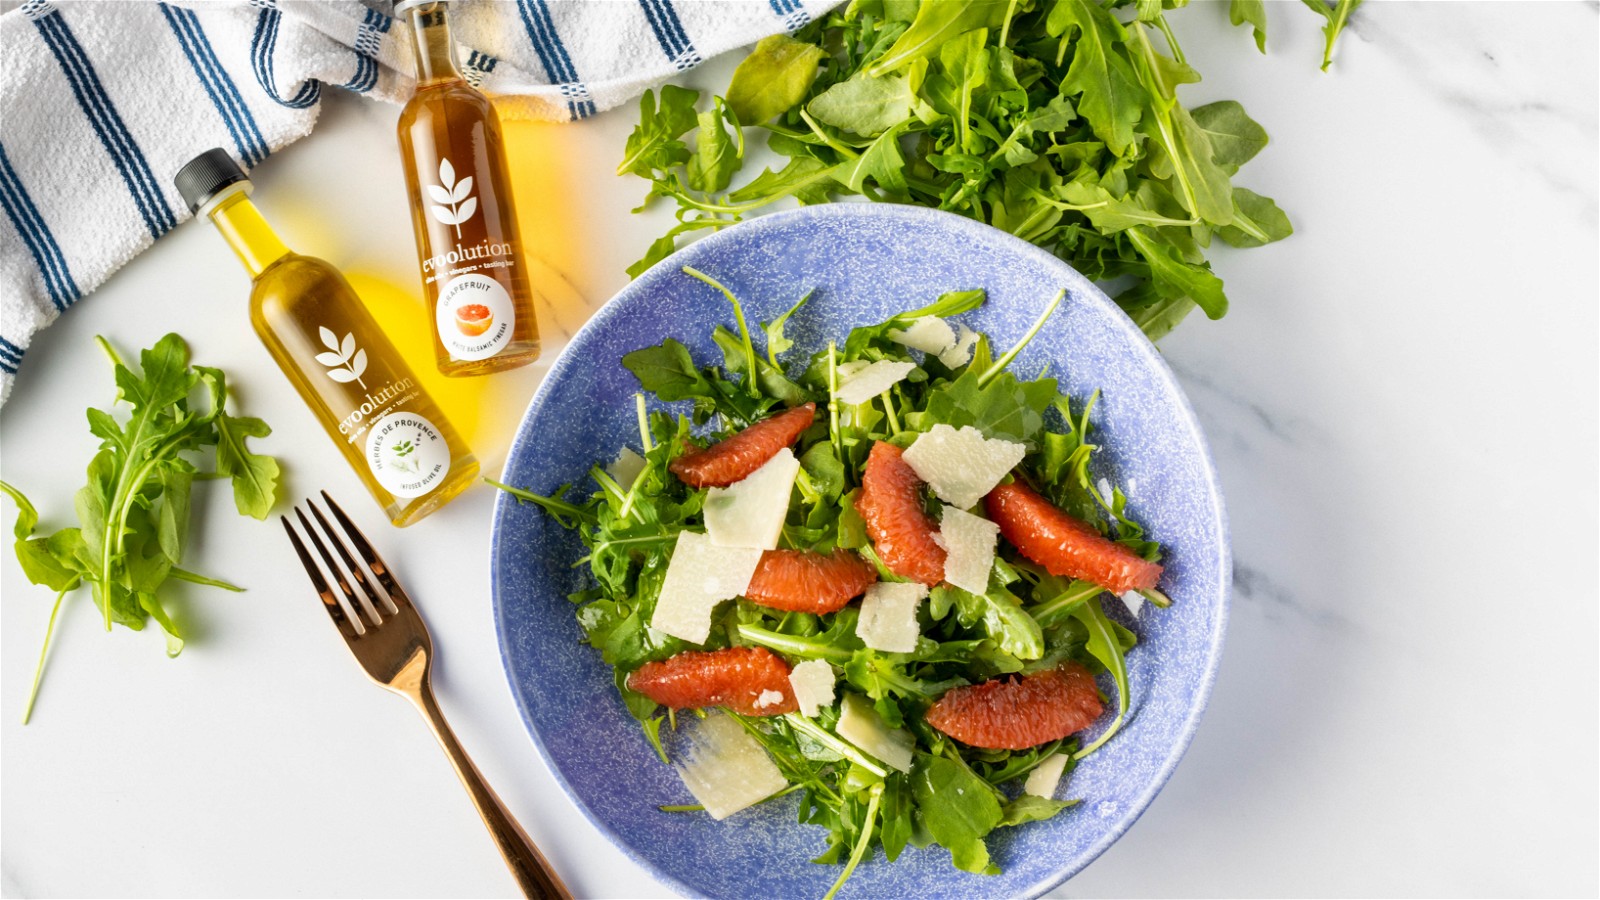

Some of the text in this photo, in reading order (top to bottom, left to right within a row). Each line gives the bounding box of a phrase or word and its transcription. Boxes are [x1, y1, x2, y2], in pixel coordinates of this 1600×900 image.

[423, 239, 513, 273] evoolution
[483, 260, 506, 269] tasting
[443, 281, 491, 307] GRAPEFRUIT
[467, 340, 493, 353] BALSAMIC
[492, 322, 508, 343] VINEGAR
[338, 377, 415, 435] evoolution
[373, 419, 438, 471] HERBES DE PROVENCE
[400, 463, 443, 490] INFUSED OLIVE OIL
